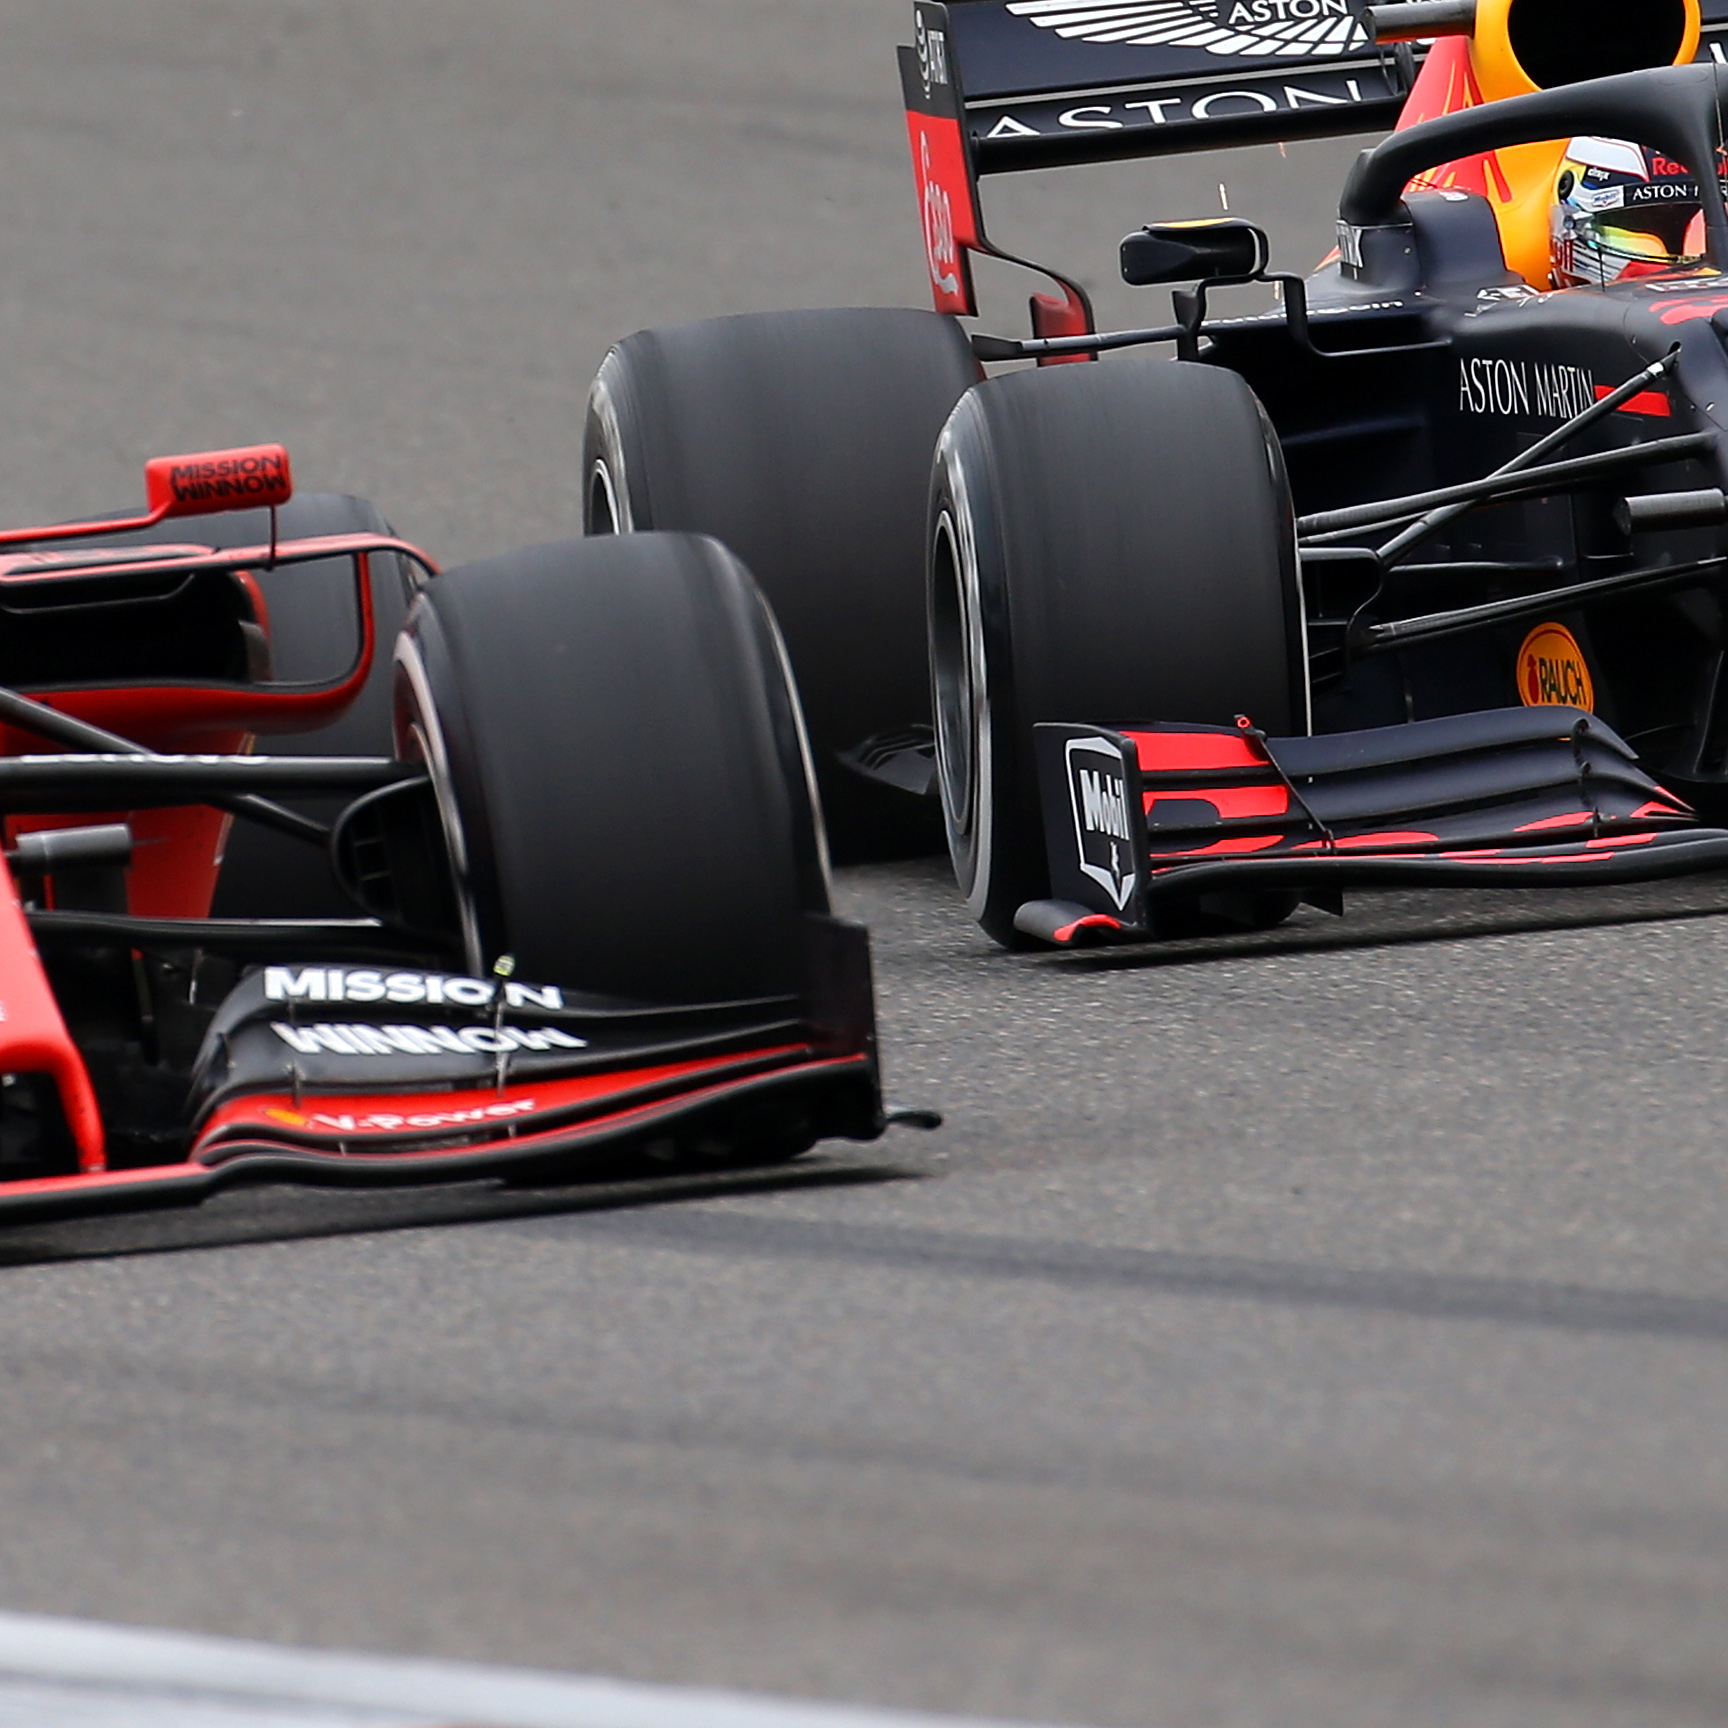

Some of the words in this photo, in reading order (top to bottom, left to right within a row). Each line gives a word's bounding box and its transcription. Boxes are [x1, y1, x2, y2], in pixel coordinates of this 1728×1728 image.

[1652, 157, 1691, 175] Re
[1633, 184, 1687, 200] ASTON
[1460, 358, 1530, 415] ASTON
[1535, 362, 1594, 419] MARTIN
[170, 456, 281, 480] MISSION
[174, 474, 286, 502] WINNOW
[1539, 657, 1587, 706] RAUCH
[1079, 769, 1130, 841] Mobil
[264, 966, 564, 1010] MISSION
[270, 1021, 589, 1055] WINNOW
[310, 1098, 535, 1131] V-Power
